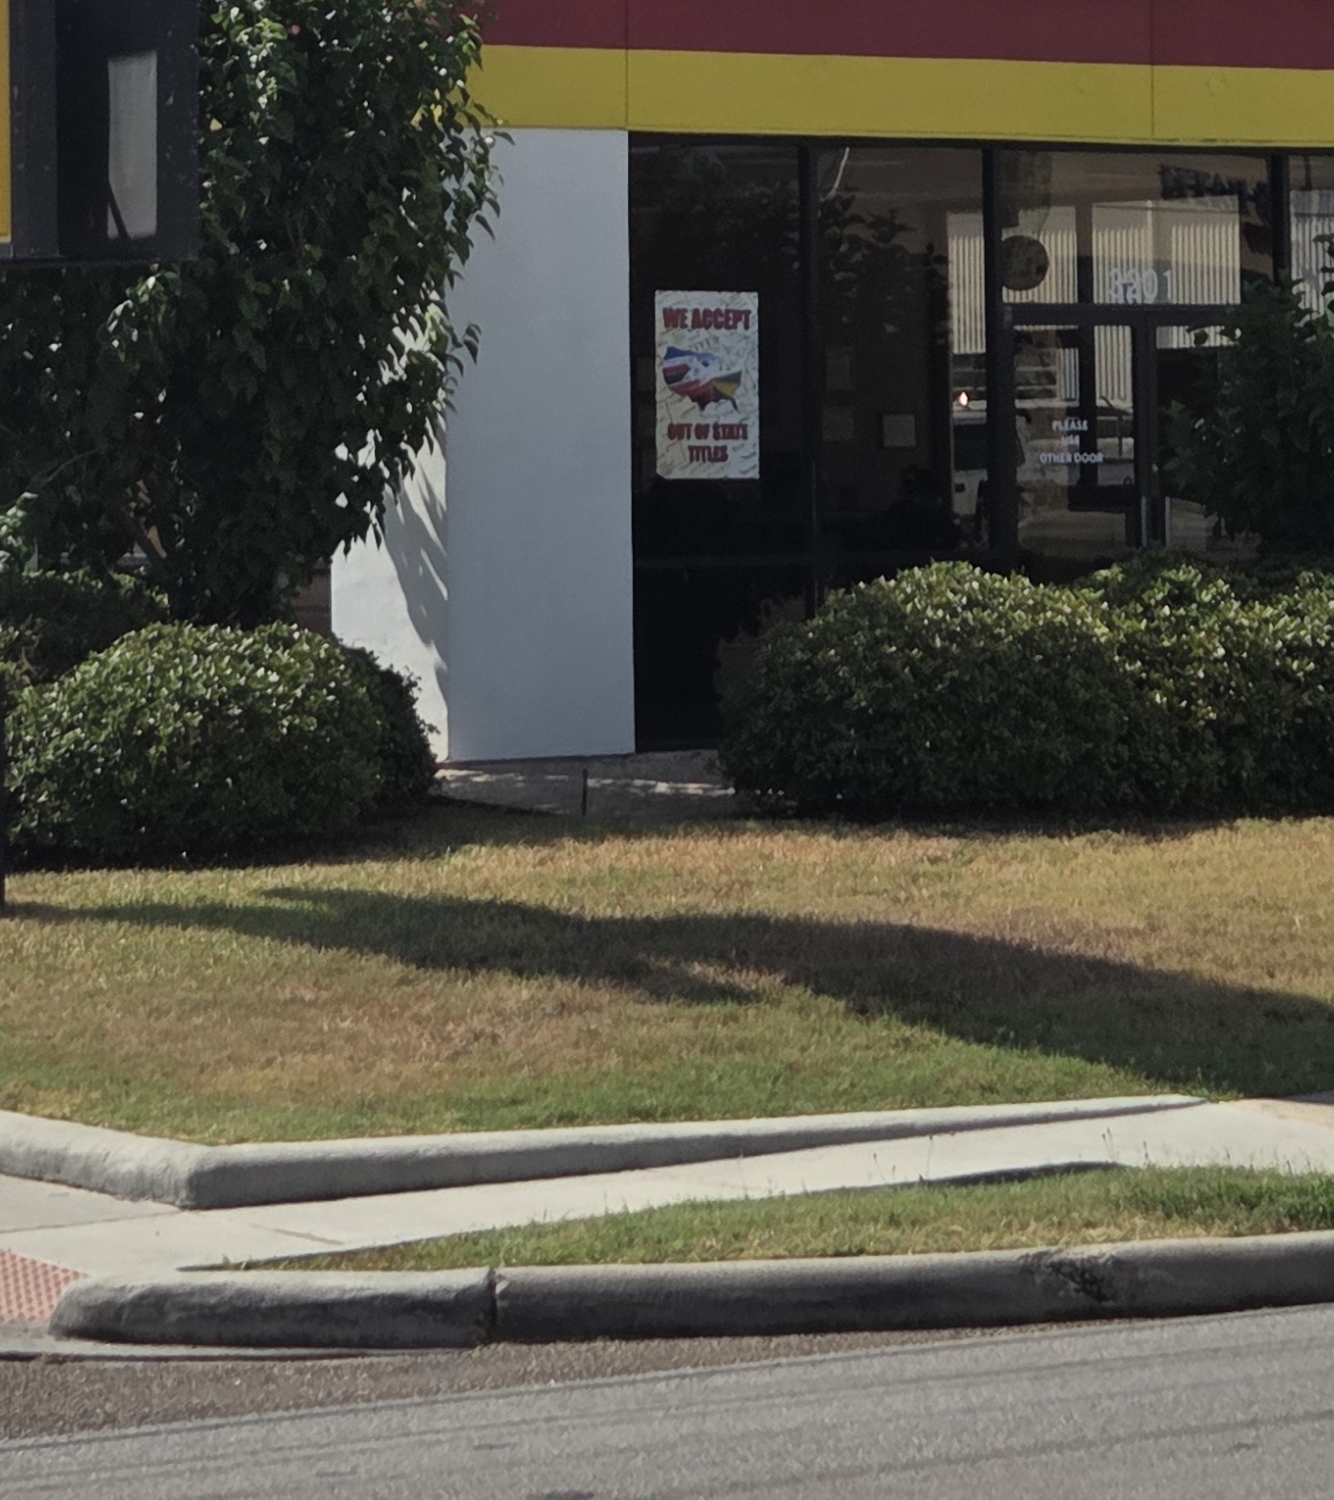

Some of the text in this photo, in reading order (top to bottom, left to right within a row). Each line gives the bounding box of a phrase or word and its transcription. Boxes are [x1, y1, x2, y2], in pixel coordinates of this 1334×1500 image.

[663, 308, 752, 330] WE ACCEPT
[667, 422, 749, 441] OUT OF STATE
[1051, 419, 1089, 432] PLEASE
[688, 445, 729, 463] TITLES
[1039, 451, 1104, 464] OTHER DOOR
